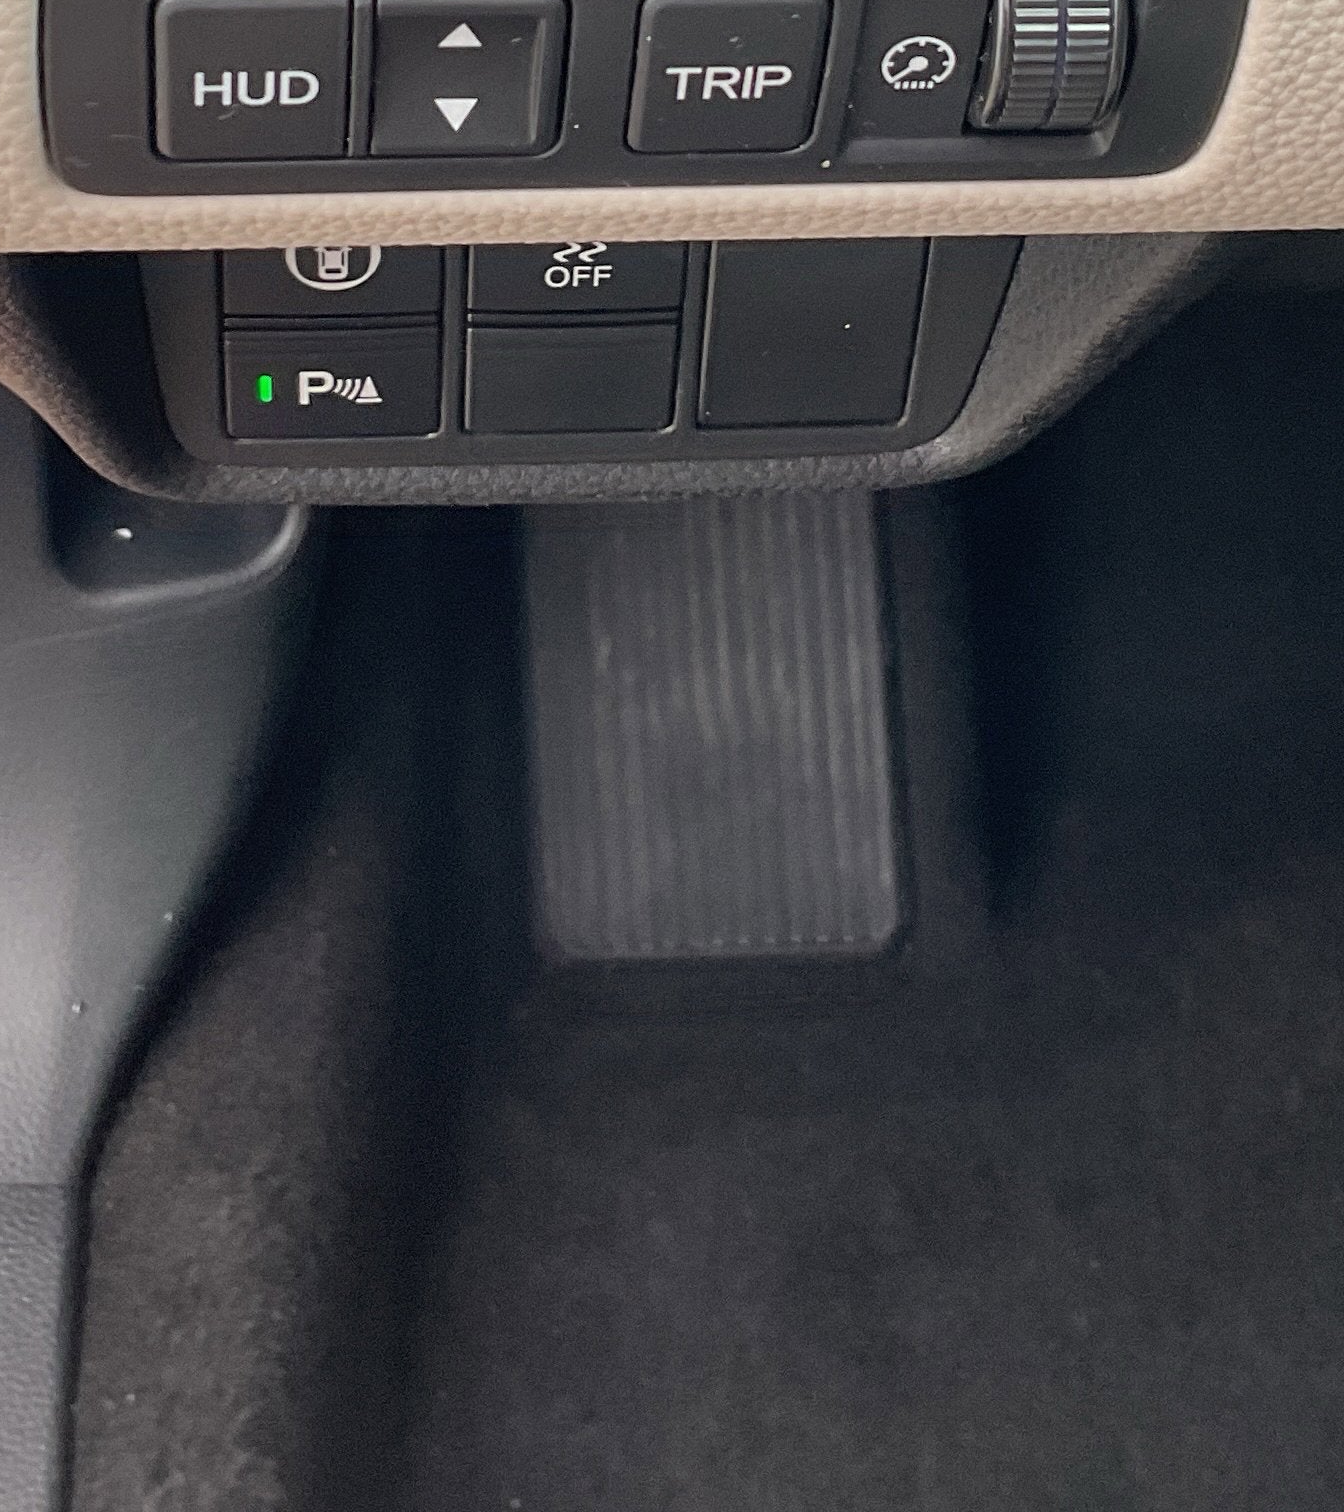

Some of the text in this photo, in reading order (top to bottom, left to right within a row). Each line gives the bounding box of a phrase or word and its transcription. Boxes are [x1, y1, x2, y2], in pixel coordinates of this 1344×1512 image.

[193, 70, 320, 106] HUD
[665, 65, 793, 101] TRIP
[544, 264, 613, 289] OFF
